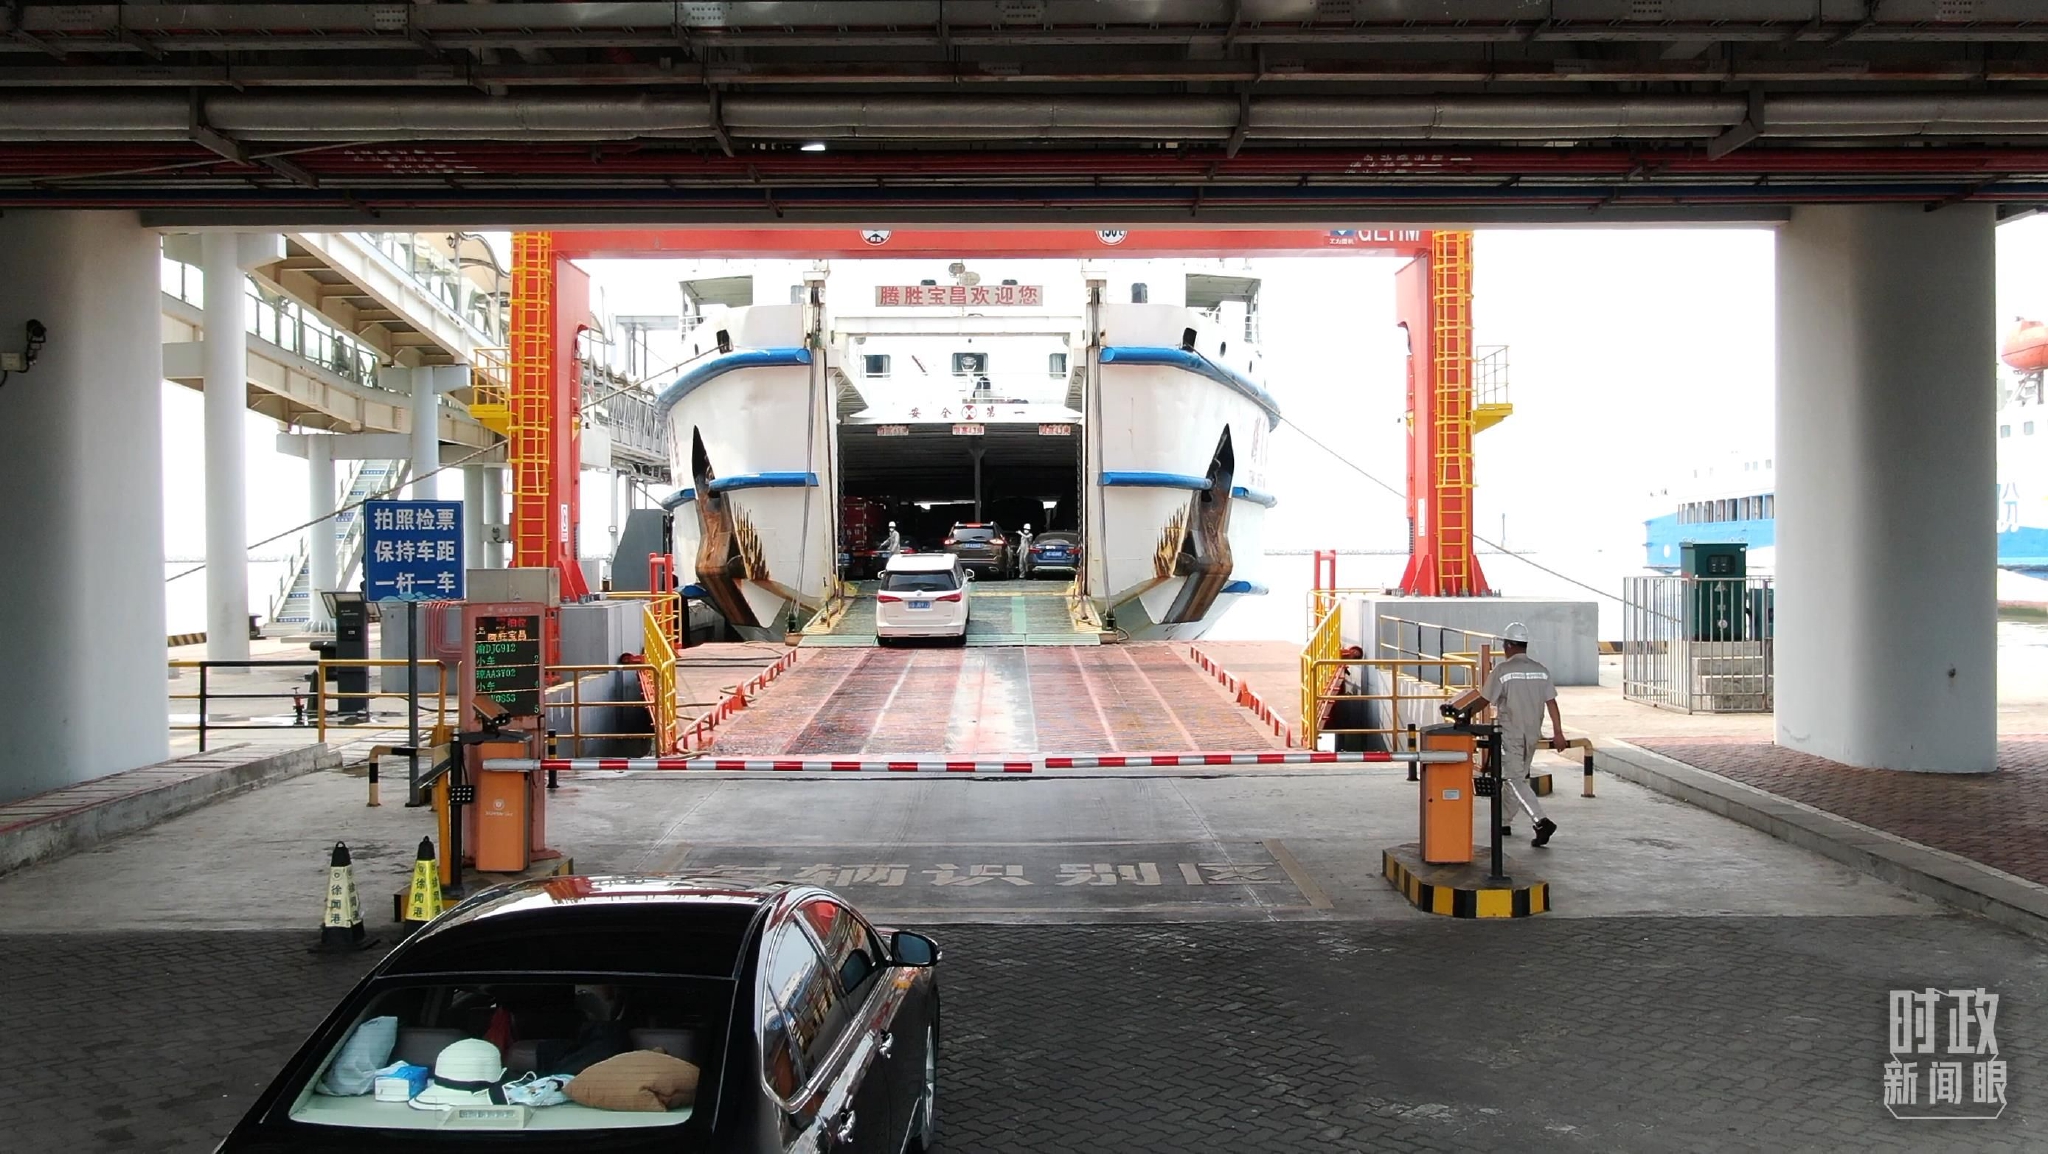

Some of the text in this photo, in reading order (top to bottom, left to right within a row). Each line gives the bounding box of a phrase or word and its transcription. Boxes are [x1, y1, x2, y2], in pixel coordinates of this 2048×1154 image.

[880, 286, 1039, 306] 腾胜宝昌欢迎您
[374, 508, 455, 531] 拍照检票
[374, 540, 455, 563] 保持车距
[375, 571, 456, 594] 一杆一车
